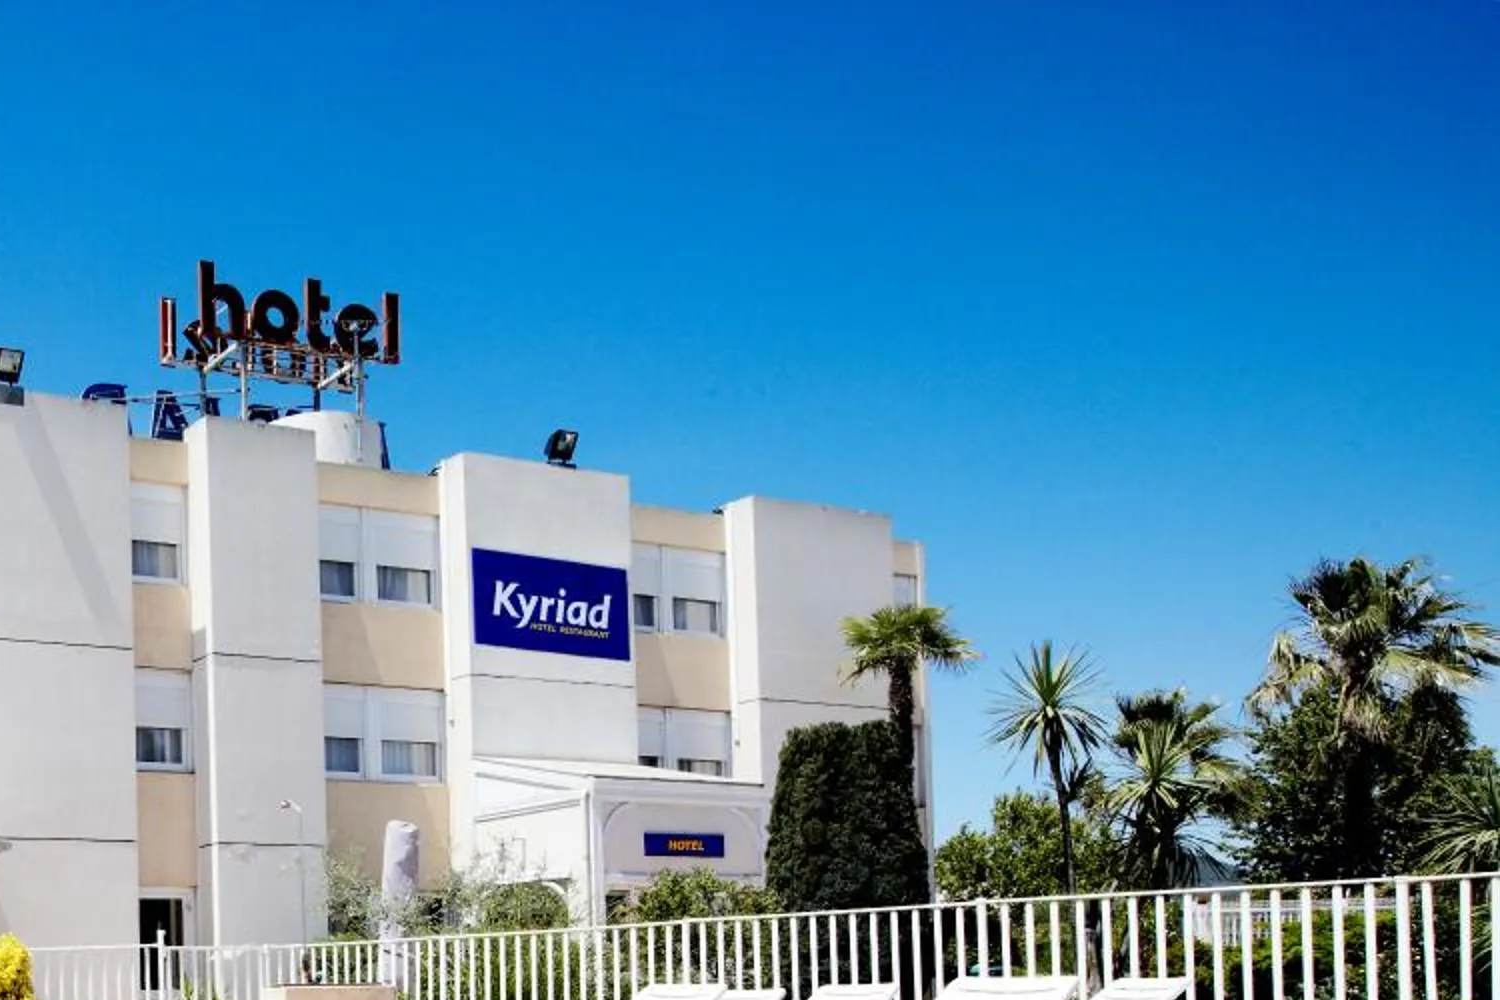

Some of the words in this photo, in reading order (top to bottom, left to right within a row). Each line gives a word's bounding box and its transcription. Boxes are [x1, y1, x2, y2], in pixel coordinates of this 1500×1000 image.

[199, 260, 399, 363] hotel
[493, 580, 612, 629] Kyriad
[668, 839, 705, 851] HOTEL
